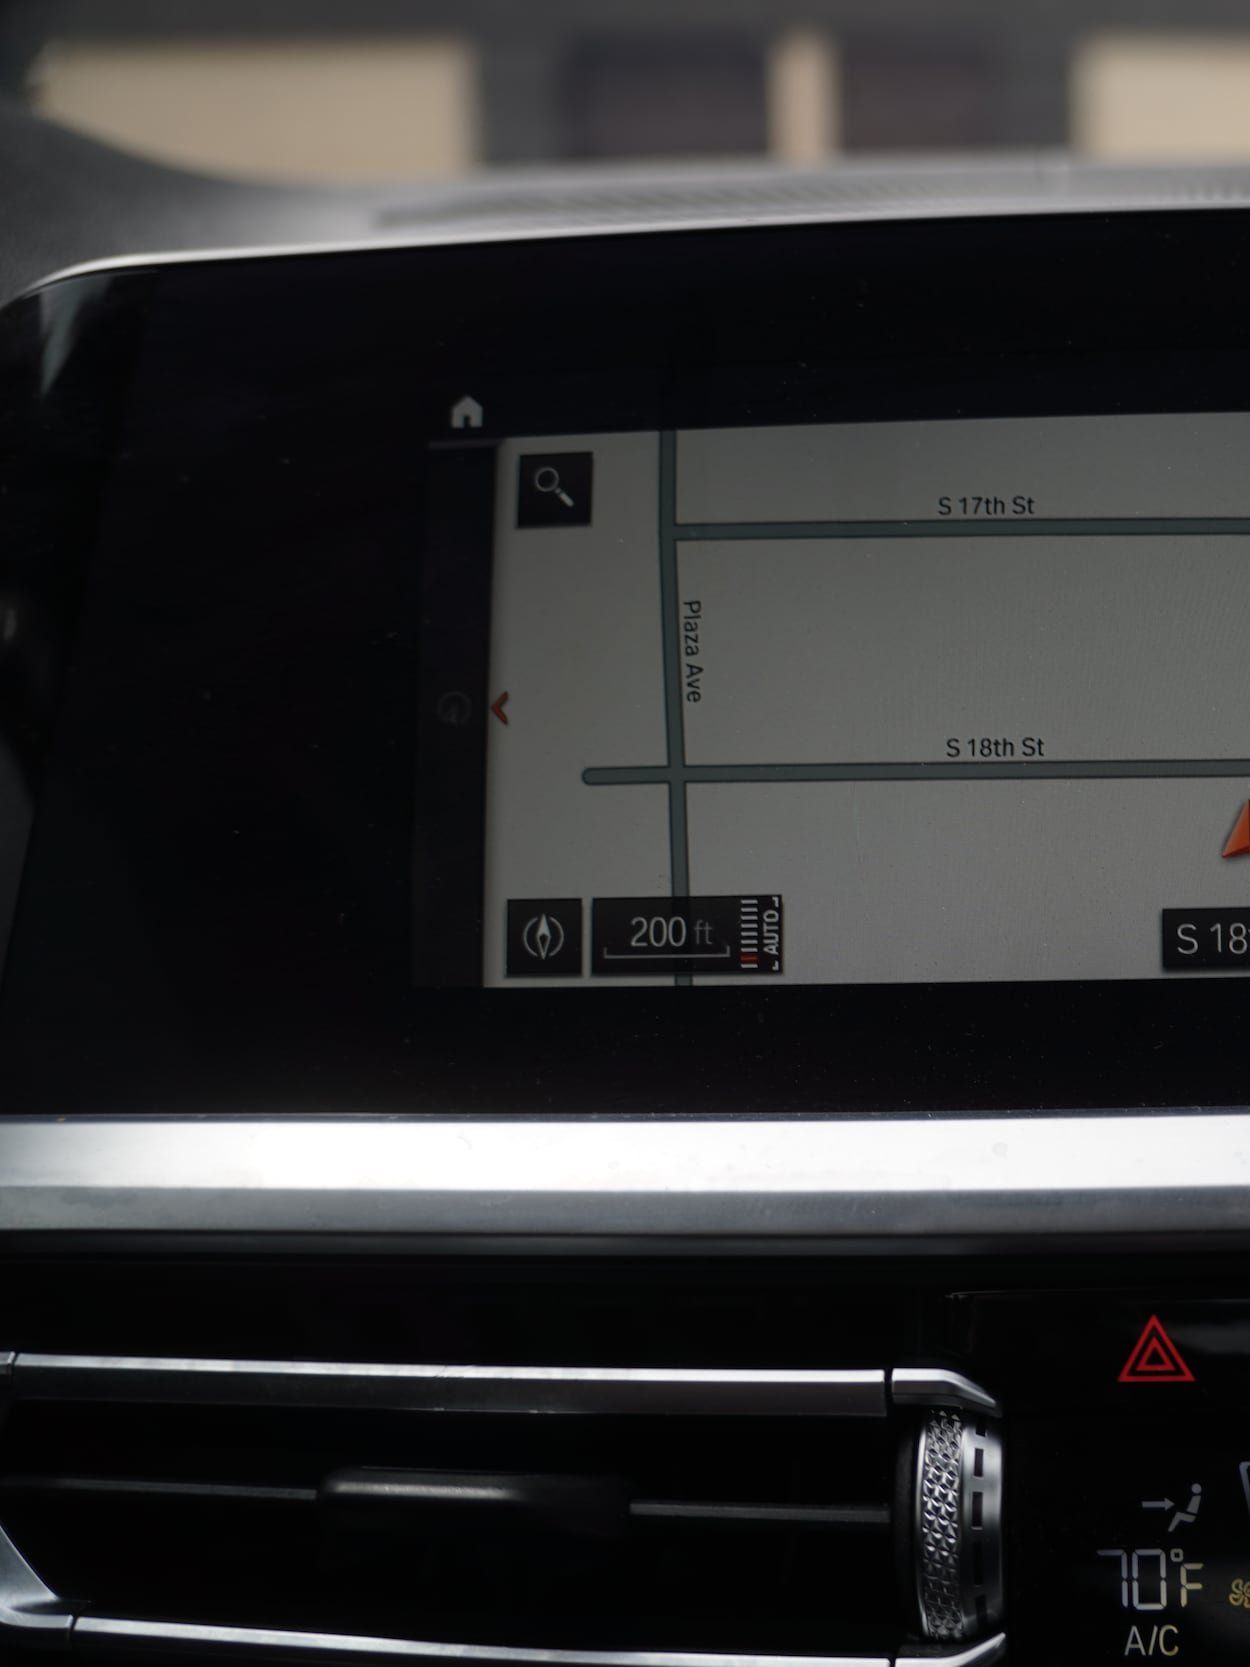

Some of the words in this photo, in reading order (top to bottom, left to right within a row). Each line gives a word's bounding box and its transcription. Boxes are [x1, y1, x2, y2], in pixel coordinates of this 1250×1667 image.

[938, 497, 951, 515] S
[958, 496, 1005, 515] 17th
[1012, 496, 1035, 514] St
[683, 600, 702, 657] Plaza
[685, 663, 704, 703] Ave
[946, 739, 960, 757] S
[967, 738, 1014, 757] 18th
[1022, 737, 1044, 756] St
[629, 916, 687, 948] 200
[693, 919, 713, 945] ft
[762, 909, 780, 956] AUTO
[1176, 923, 1199, 955] S
[1124, 1625, 1179, 1656] A/C
